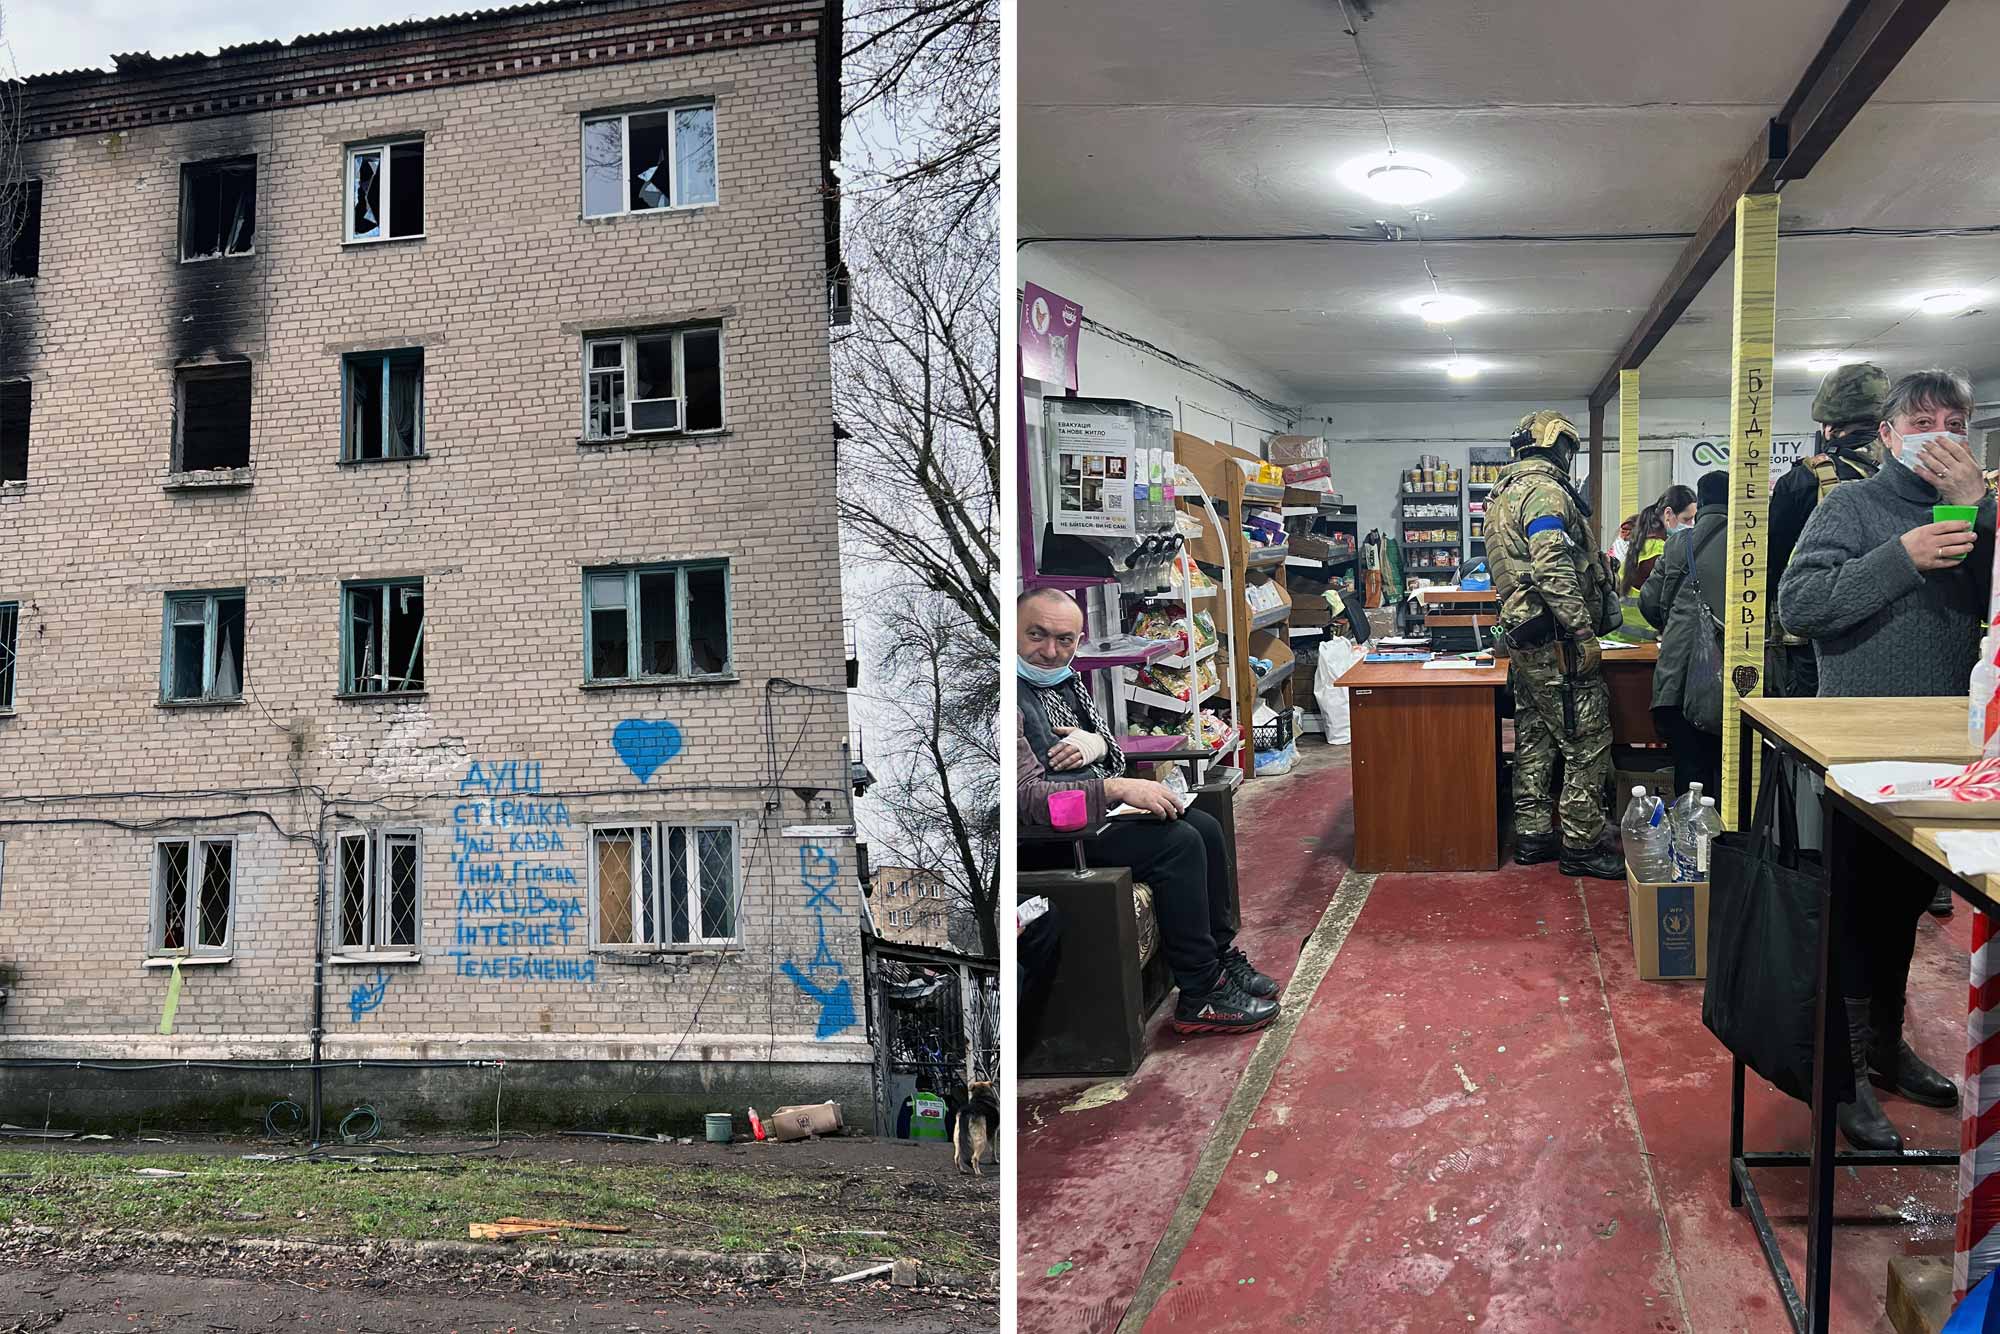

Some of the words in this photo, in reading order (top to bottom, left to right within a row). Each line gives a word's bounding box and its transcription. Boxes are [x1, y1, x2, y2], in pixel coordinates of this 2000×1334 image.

[1773, 442, 1803, 455] ITY
[1769, 456, 1803, 465] EOPLE
[459, 760, 542, 794] ДУШ
[453, 798, 572, 828] СТІРАЛКА
[509, 830, 565, 851] КАВА
